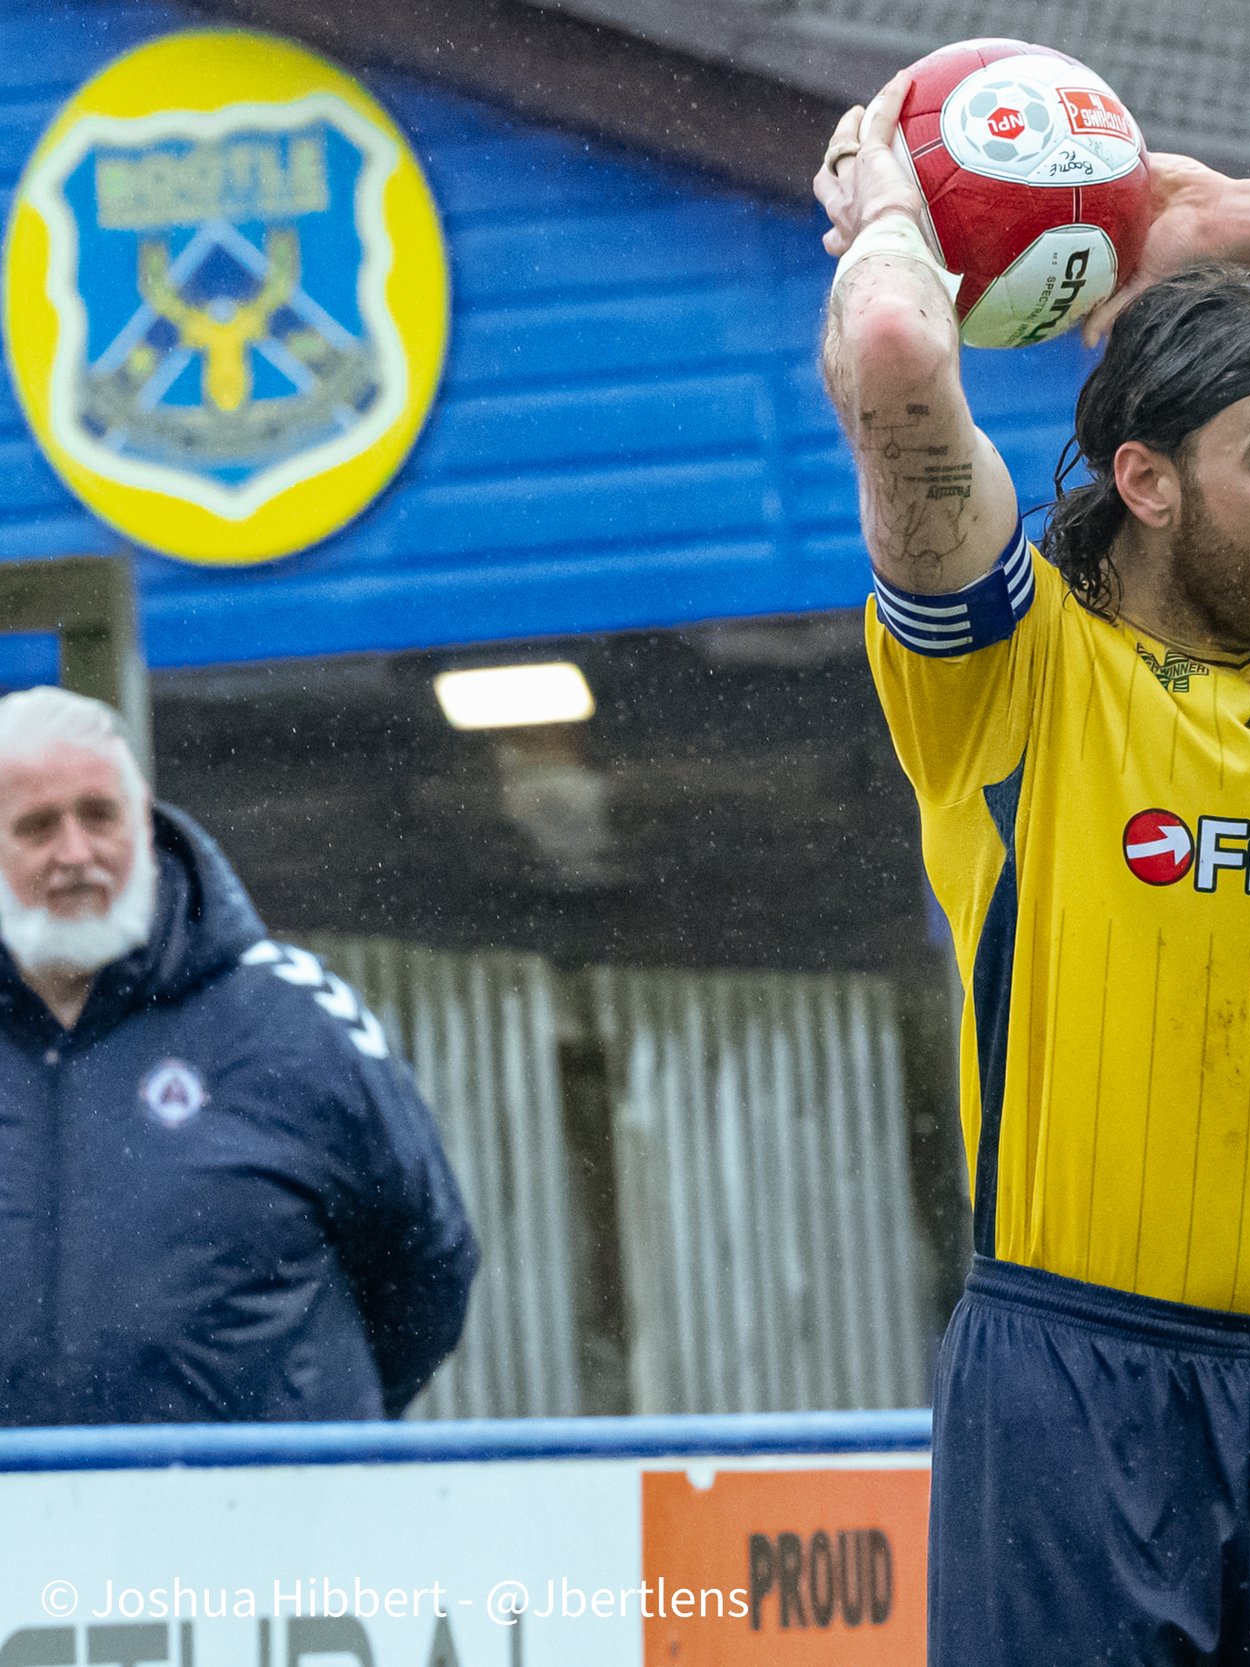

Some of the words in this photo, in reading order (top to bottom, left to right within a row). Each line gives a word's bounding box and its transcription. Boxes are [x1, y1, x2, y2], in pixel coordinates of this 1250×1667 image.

[987, 113, 1025, 133] NPL
[1059, 151, 1076, 161] FC
[749, 1528, 893, 1632] PROUD
